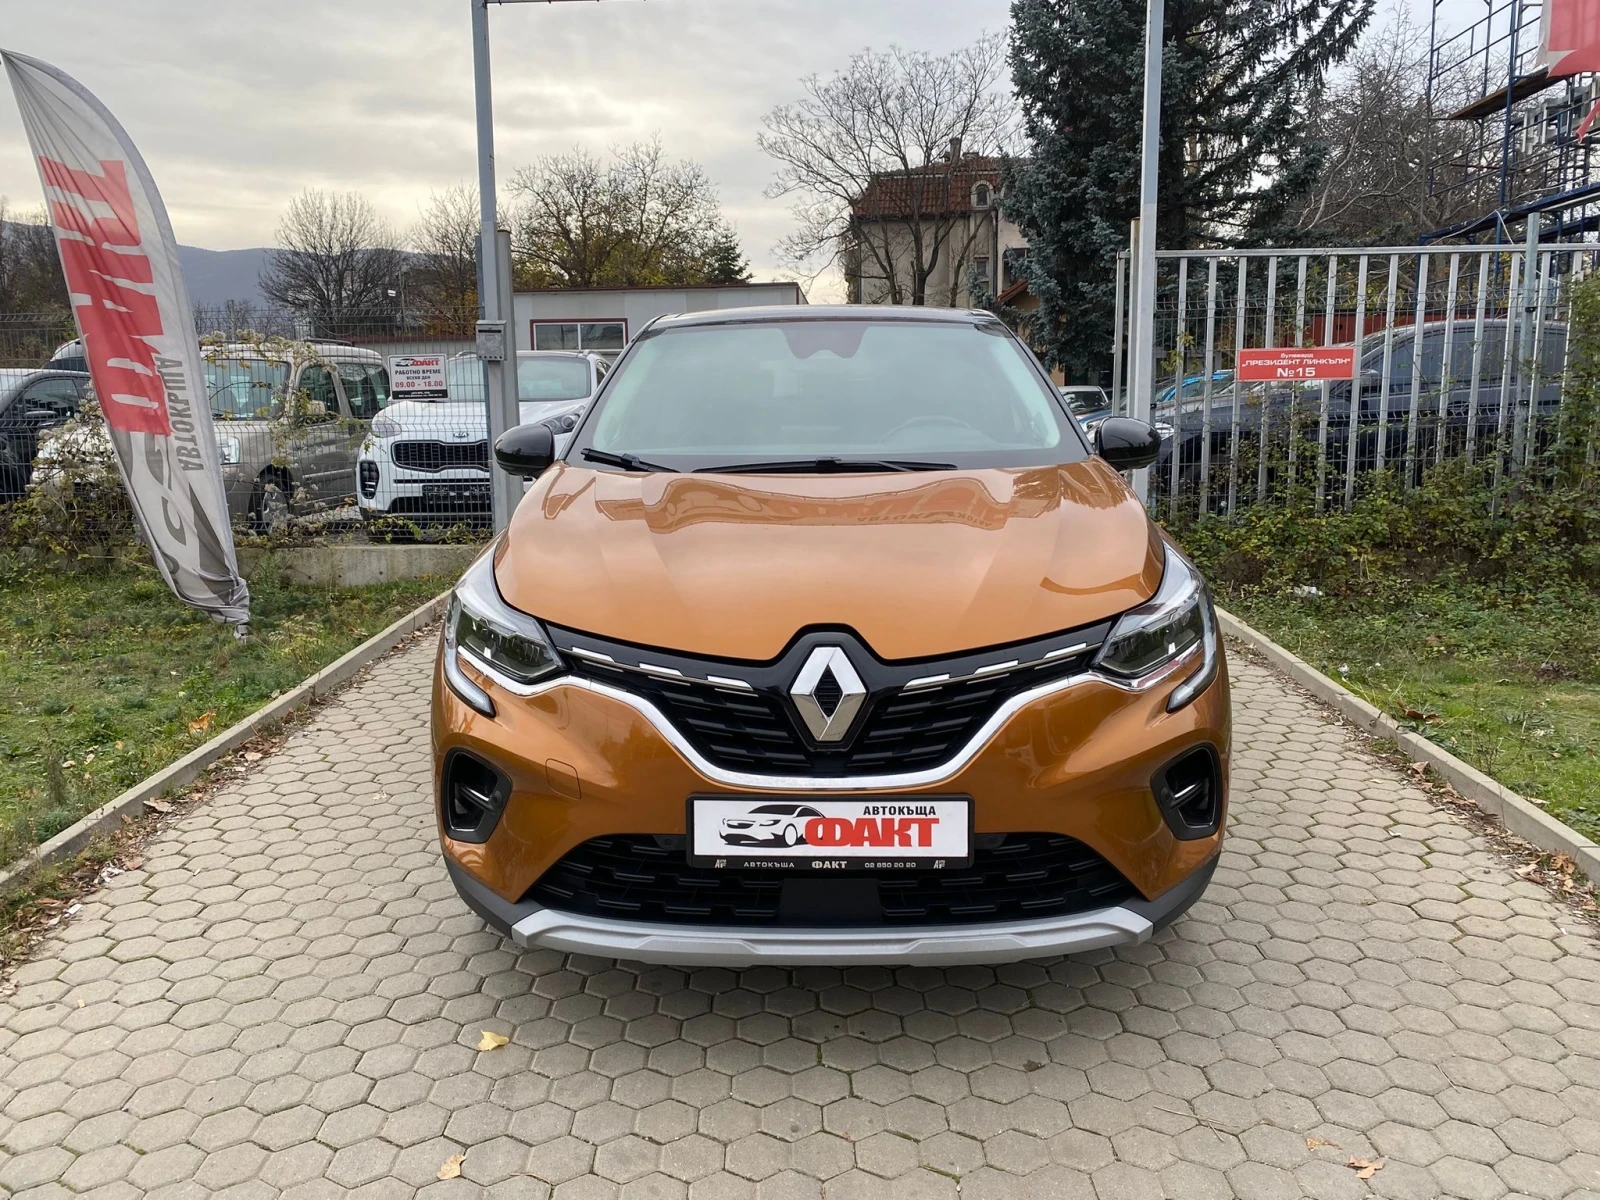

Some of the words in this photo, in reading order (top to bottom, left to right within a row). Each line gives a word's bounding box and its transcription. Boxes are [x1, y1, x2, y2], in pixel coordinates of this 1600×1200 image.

[863, 805, 937, 816] АВТОКЪЩА
[804, 817, 940, 847] ФАКТ
[811, 860, 848, 869] ФАКТ
